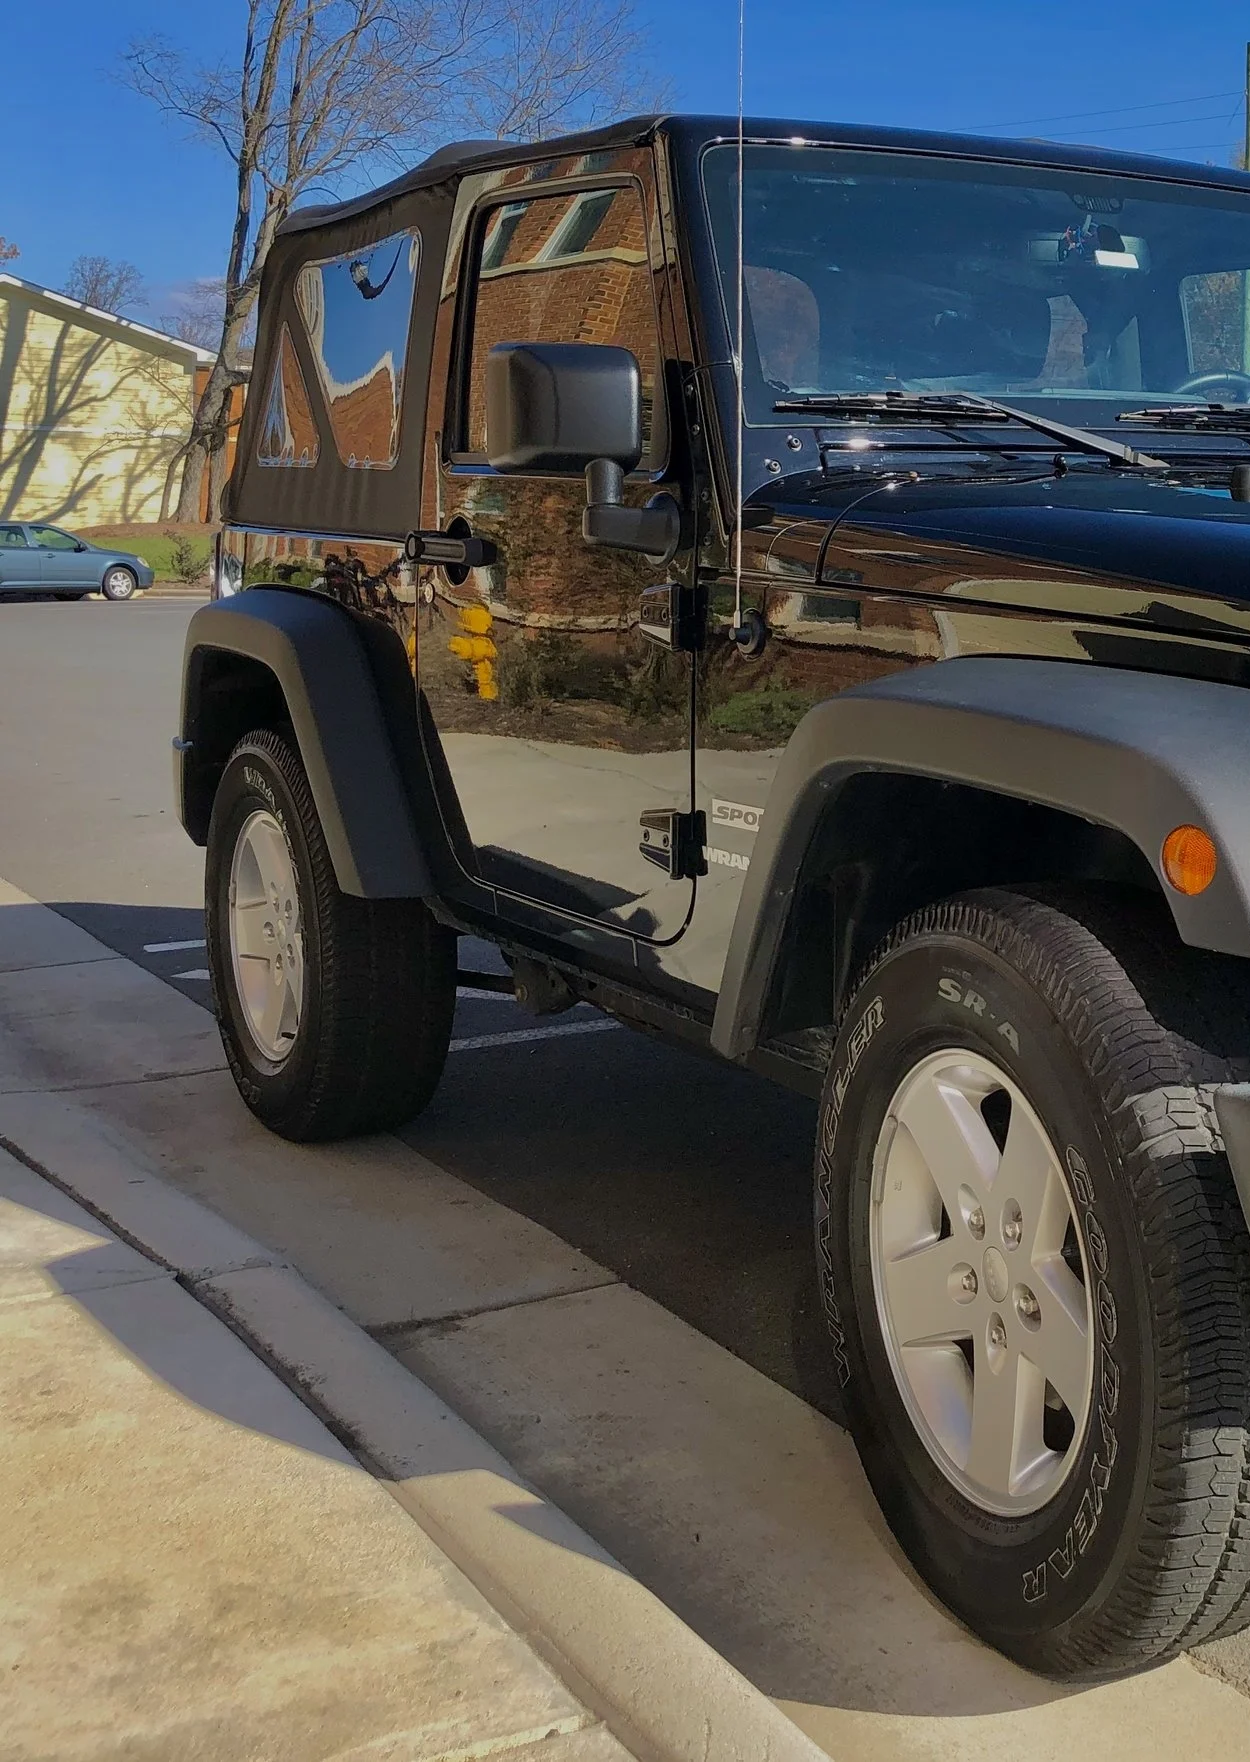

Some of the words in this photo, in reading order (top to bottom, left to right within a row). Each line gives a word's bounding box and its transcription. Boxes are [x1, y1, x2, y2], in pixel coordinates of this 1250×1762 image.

[712, 805, 761, 826] SPO
[817, 996, 884, 1389] WRANGLER
[1022, 1144, 1119, 1602] GOODYEAR
